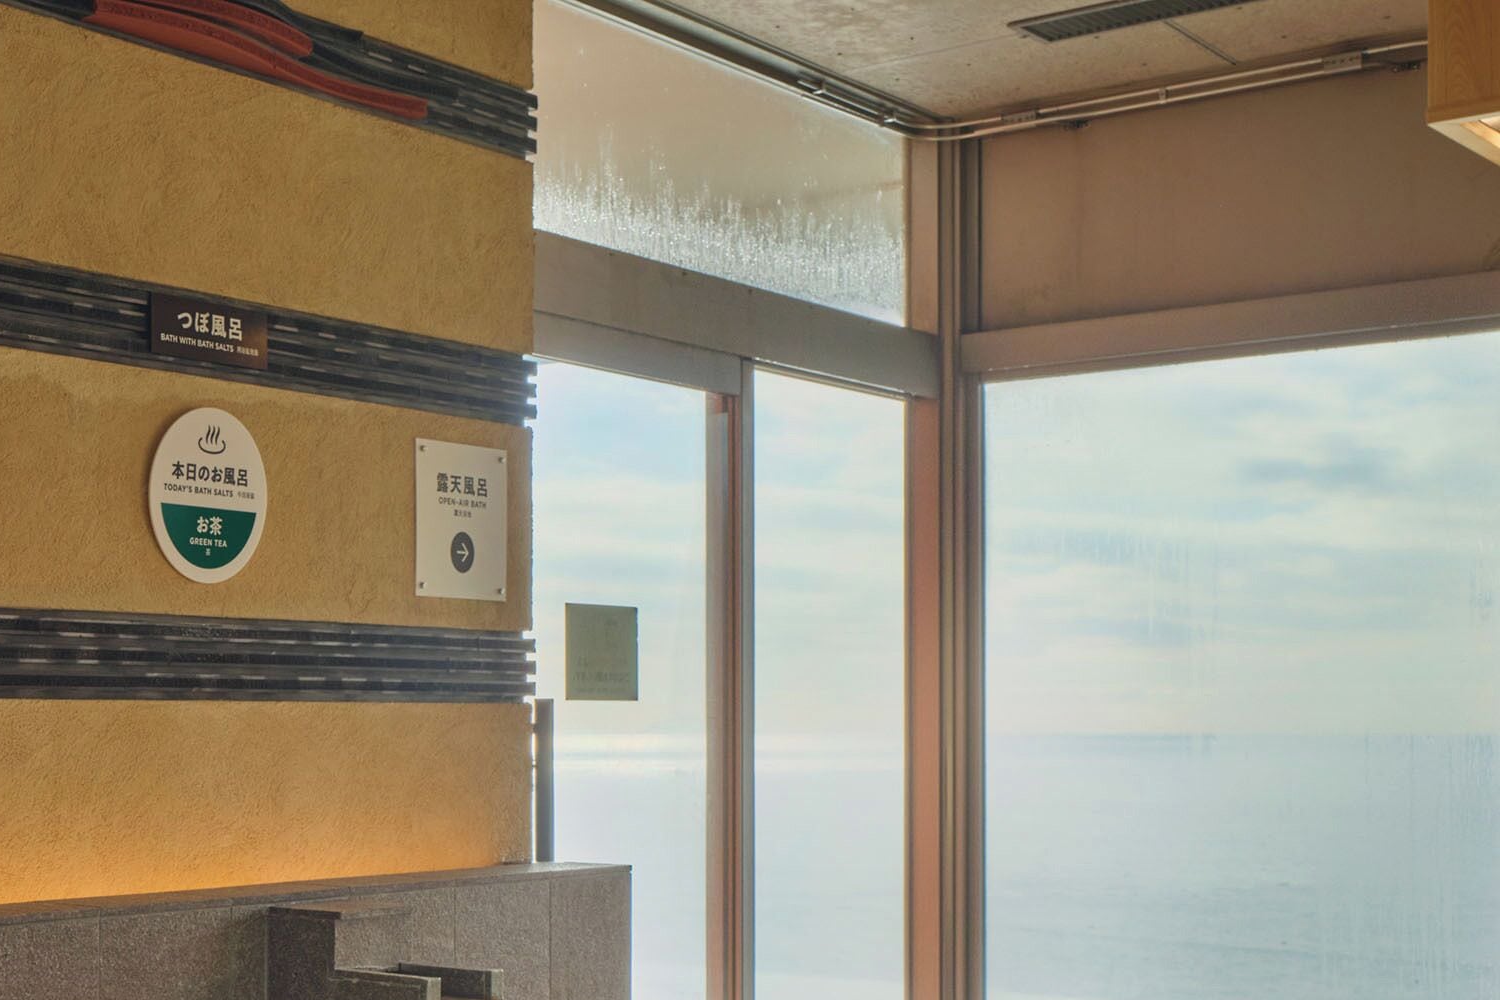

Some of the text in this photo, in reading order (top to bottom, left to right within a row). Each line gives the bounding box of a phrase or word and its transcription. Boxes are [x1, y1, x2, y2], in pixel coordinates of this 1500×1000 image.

[177, 312, 243, 341] つぼ風呂
[160, 333, 178, 343] BATH
[179, 336, 196, 346] WITH
[197, 339, 214, 349] BATH
[215, 342, 234, 352] SALTS
[172, 460, 248, 487] 本日のお風呂
[164, 482, 193, 493] TODAY'S
[194, 486, 212, 496] BATH
[213, 489, 233, 498] SALTS
[437, 472, 488, 497] 露天風呂
[196, 516, 223, 535] お茶
[189, 537, 227, 548] GREEN TEA
